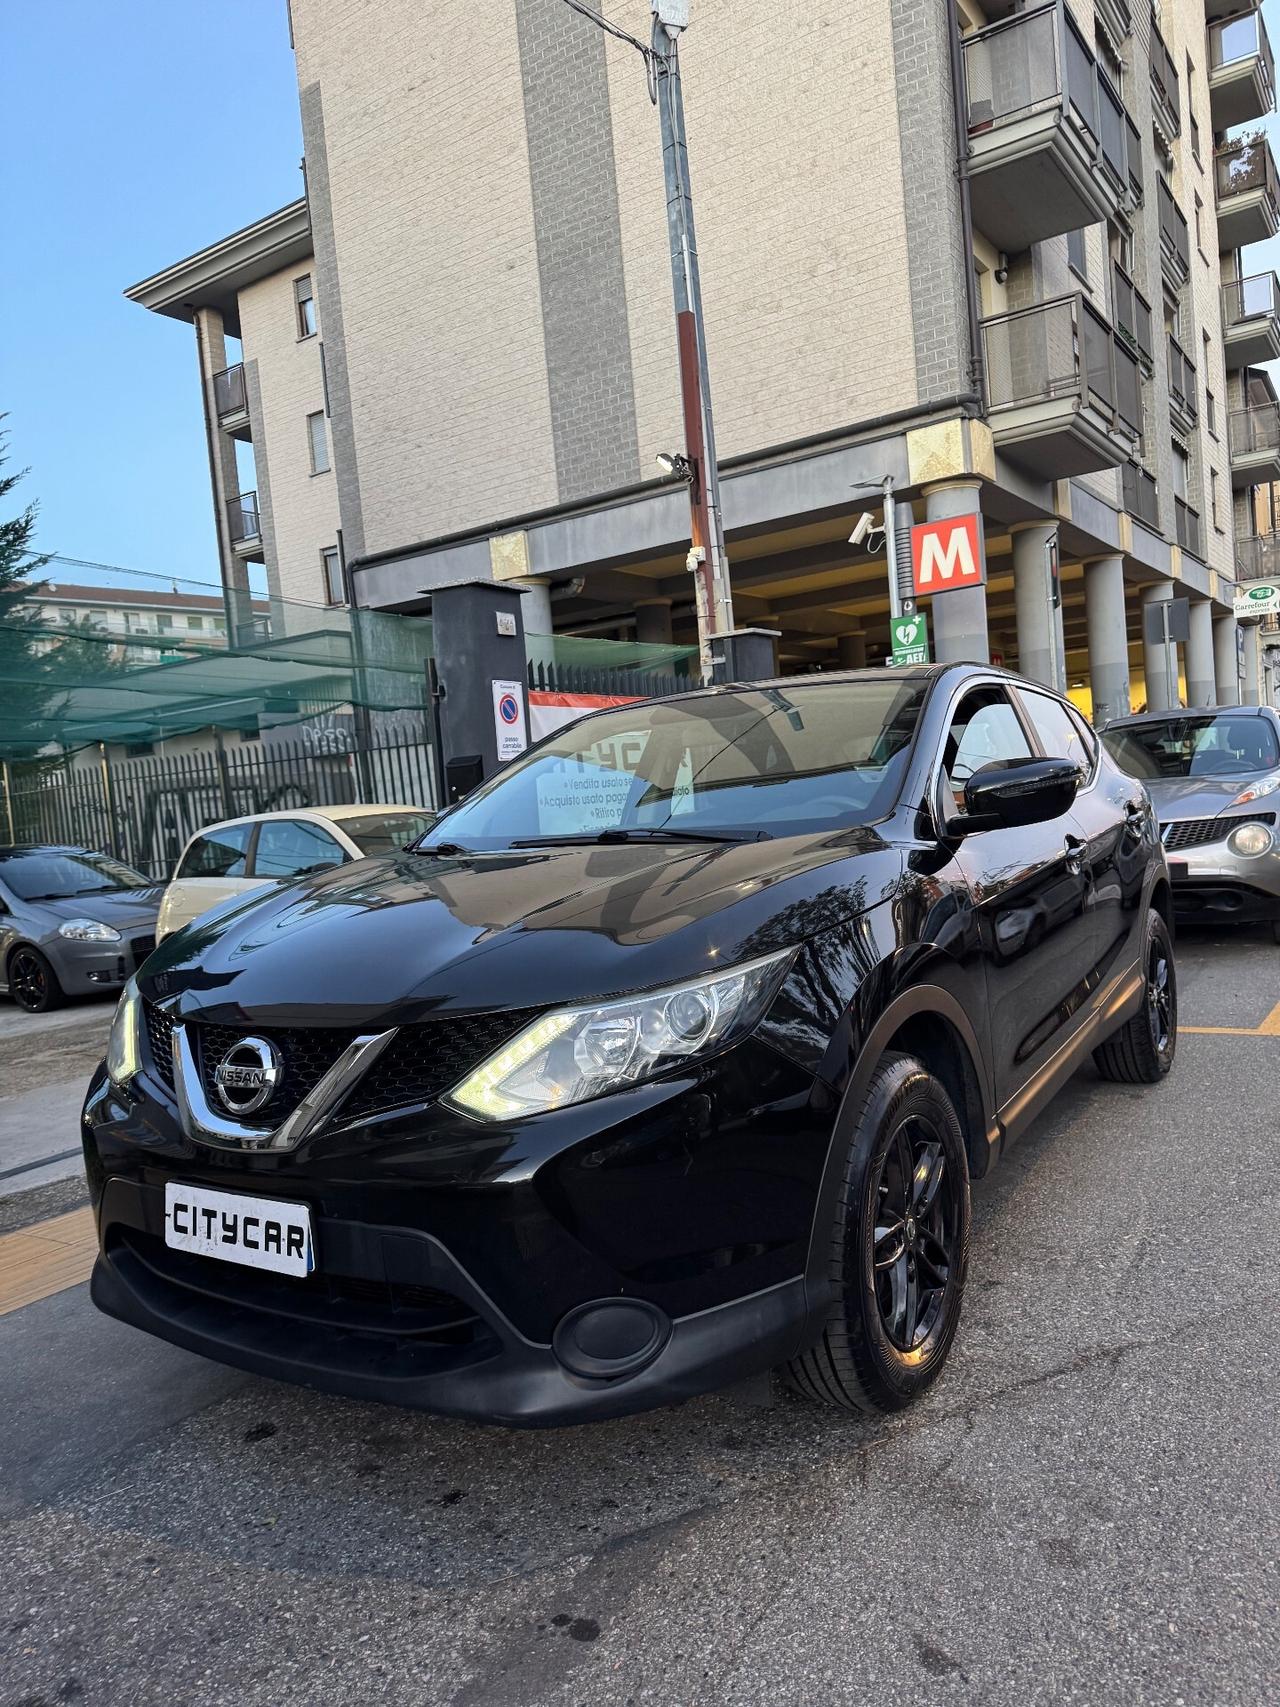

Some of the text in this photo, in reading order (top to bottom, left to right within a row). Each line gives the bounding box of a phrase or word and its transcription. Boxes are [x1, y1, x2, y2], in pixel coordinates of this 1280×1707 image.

[919, 526, 976, 584] M
[1235, 602, 1270, 610] Carrefour
[568, 777, 633, 790] Vendita usato se
[544, 794, 580, 808] Acquisto
[582, 793, 604, 804] usato
[595, 806, 615, 819] Ritiro
[217, 1066, 264, 1084] NISSAN
[174, 1203, 304, 1259] CITYCAR
